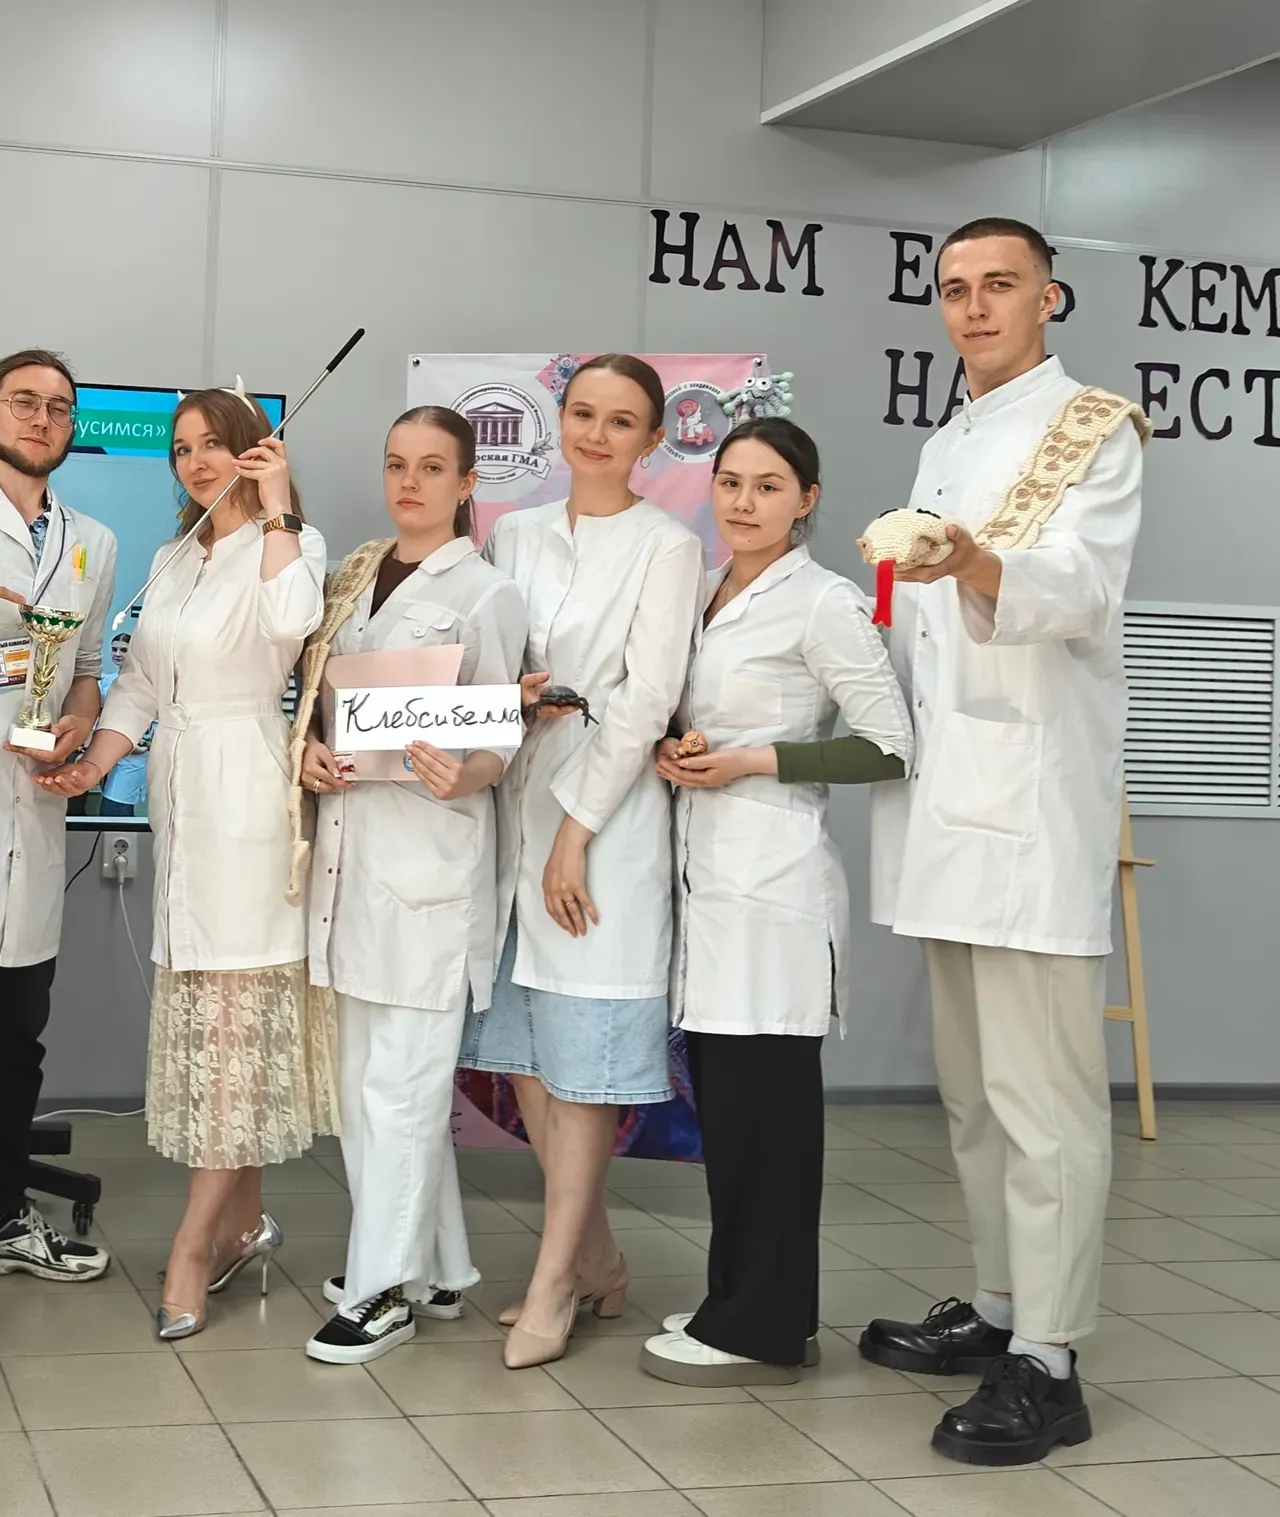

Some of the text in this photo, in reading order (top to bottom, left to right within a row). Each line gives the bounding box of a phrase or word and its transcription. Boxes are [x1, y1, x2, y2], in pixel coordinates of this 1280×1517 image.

[648, 208, 825, 297] НАМ
[1137, 255, 1280, 338] КЕМ
[511, 453, 539, 468] ГМА
[342, 692, 520, 734] Клебсибелла
